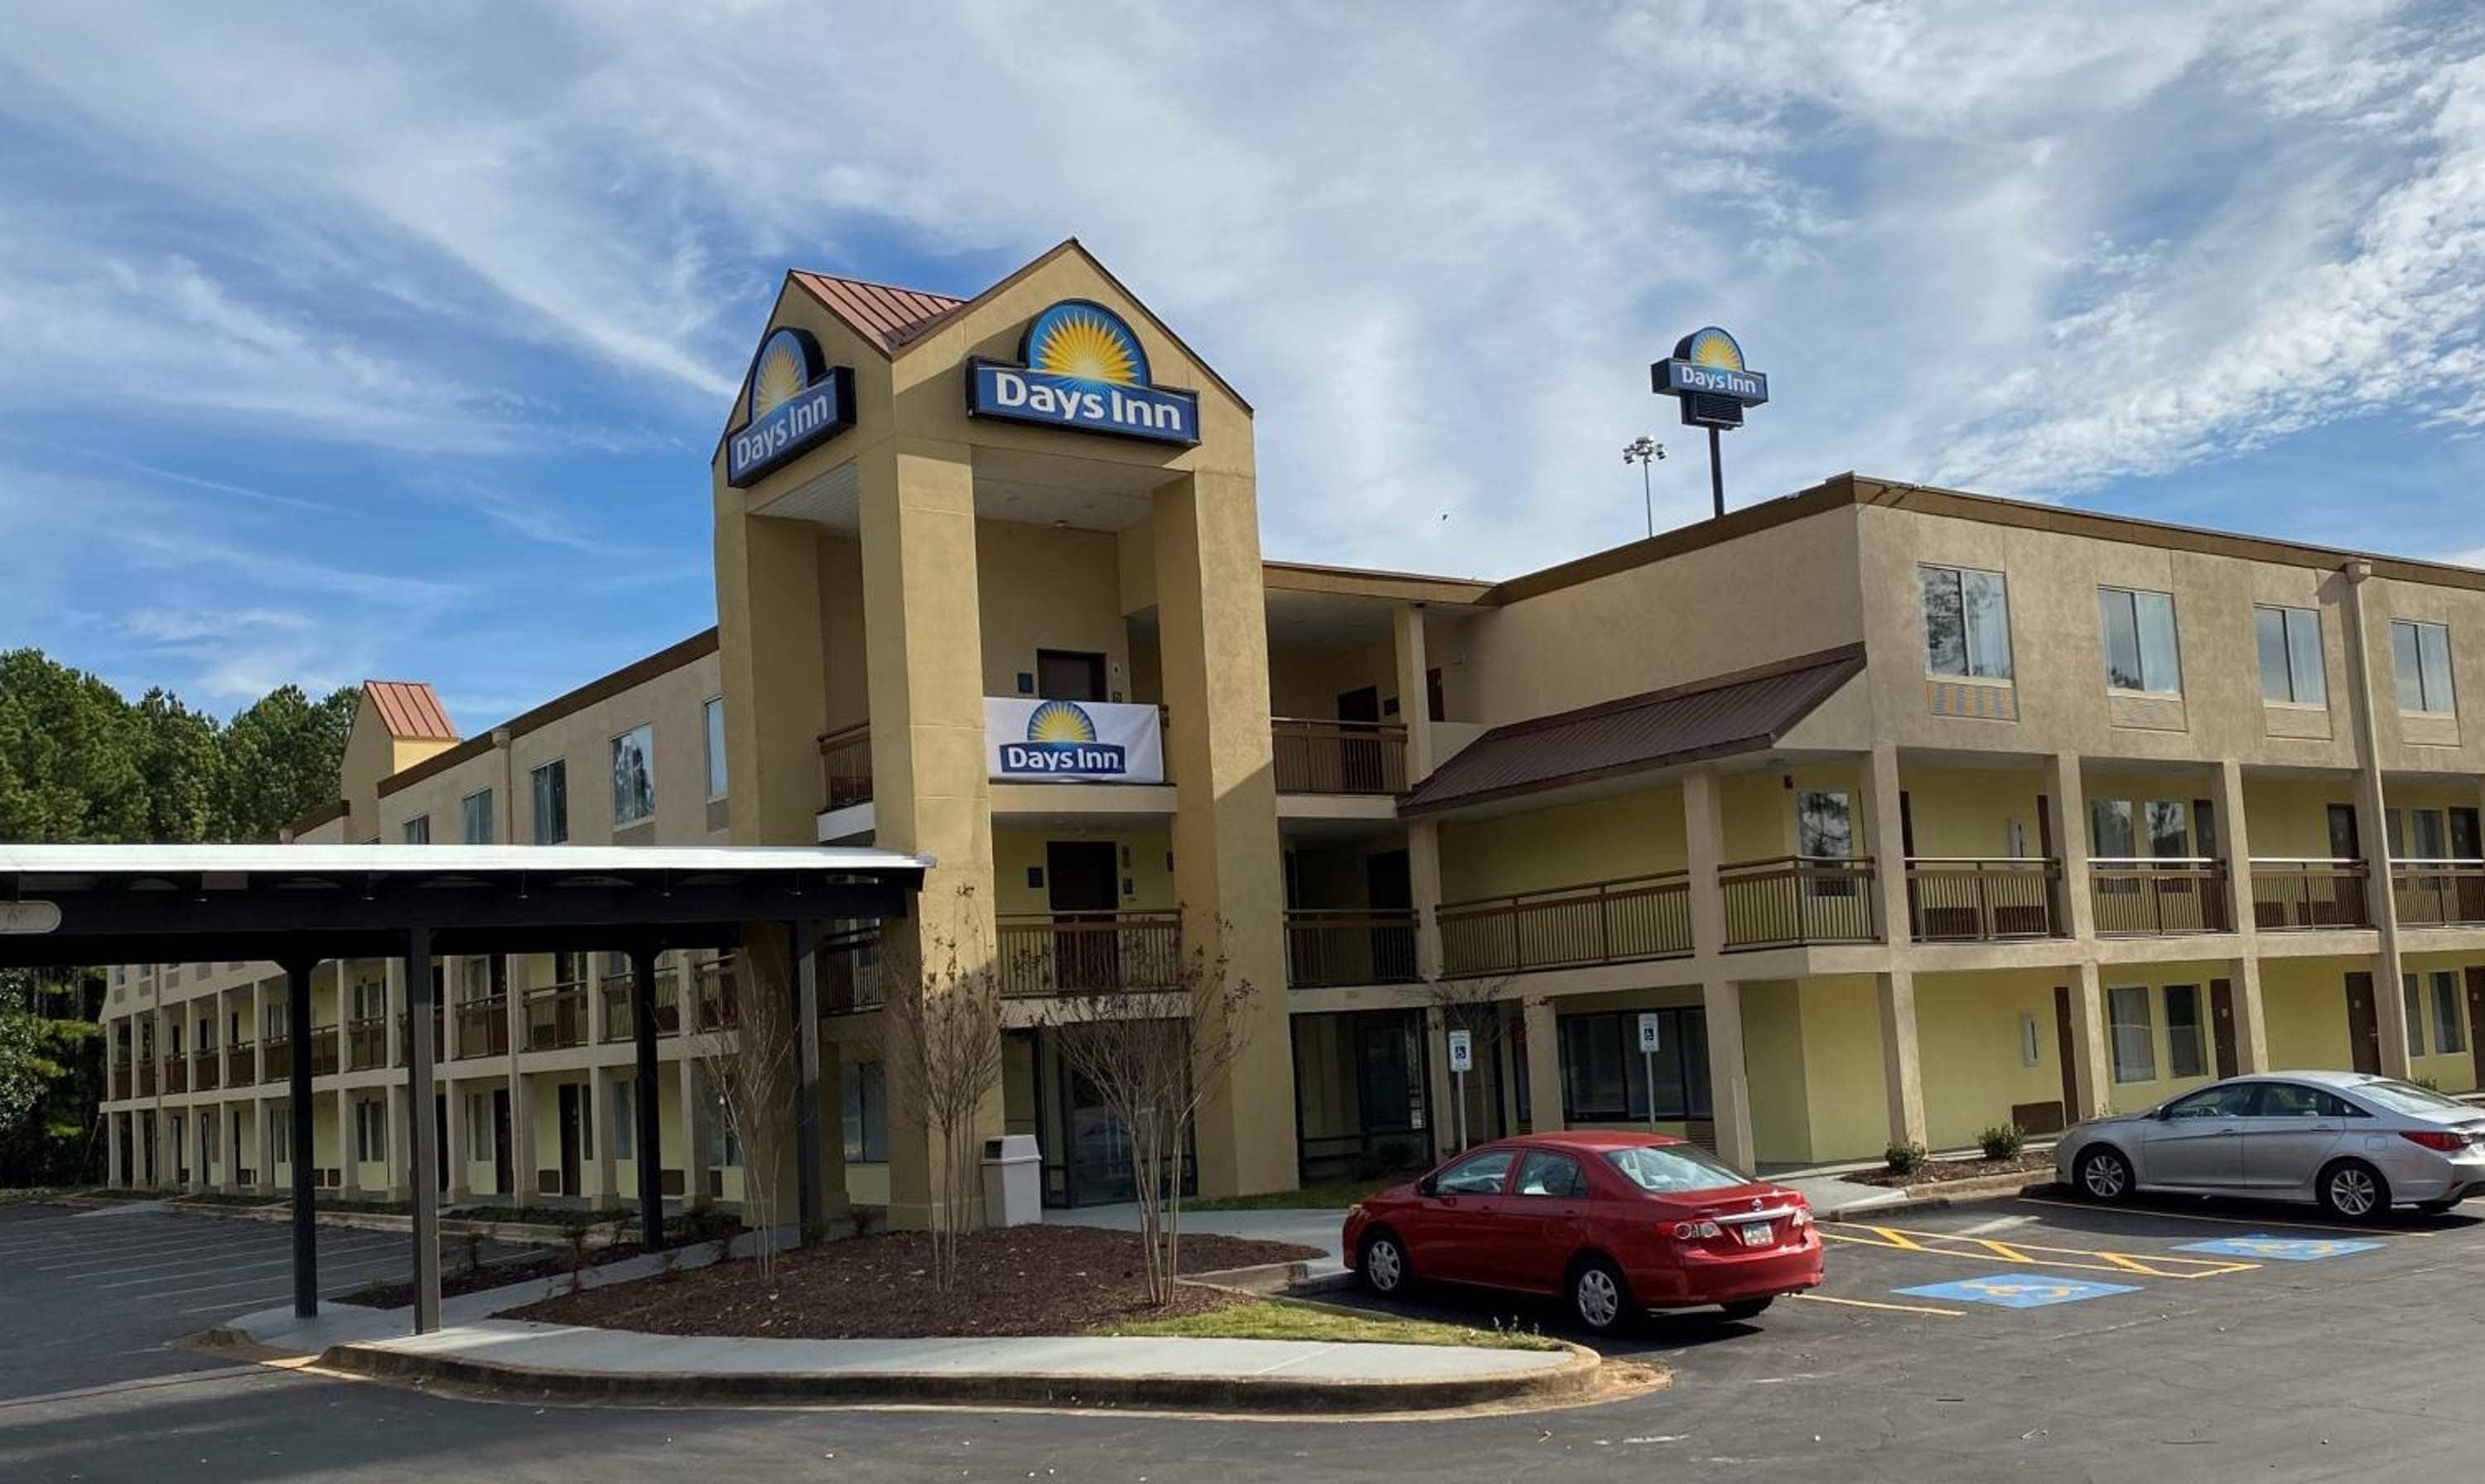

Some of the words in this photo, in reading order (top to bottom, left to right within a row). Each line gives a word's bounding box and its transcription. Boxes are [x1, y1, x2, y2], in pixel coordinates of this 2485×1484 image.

[996, 372, 1104, 420] Days
[1111, 390, 1180, 430] Inn
[1682, 366, 1725, 389] Days
[1727, 373, 1756, 394] Inn
[736, 418, 788, 470] Days
[789, 395, 828, 437] Inn
[1008, 747, 1074, 771] Days
[1078, 749, 1118, 769] Inn
